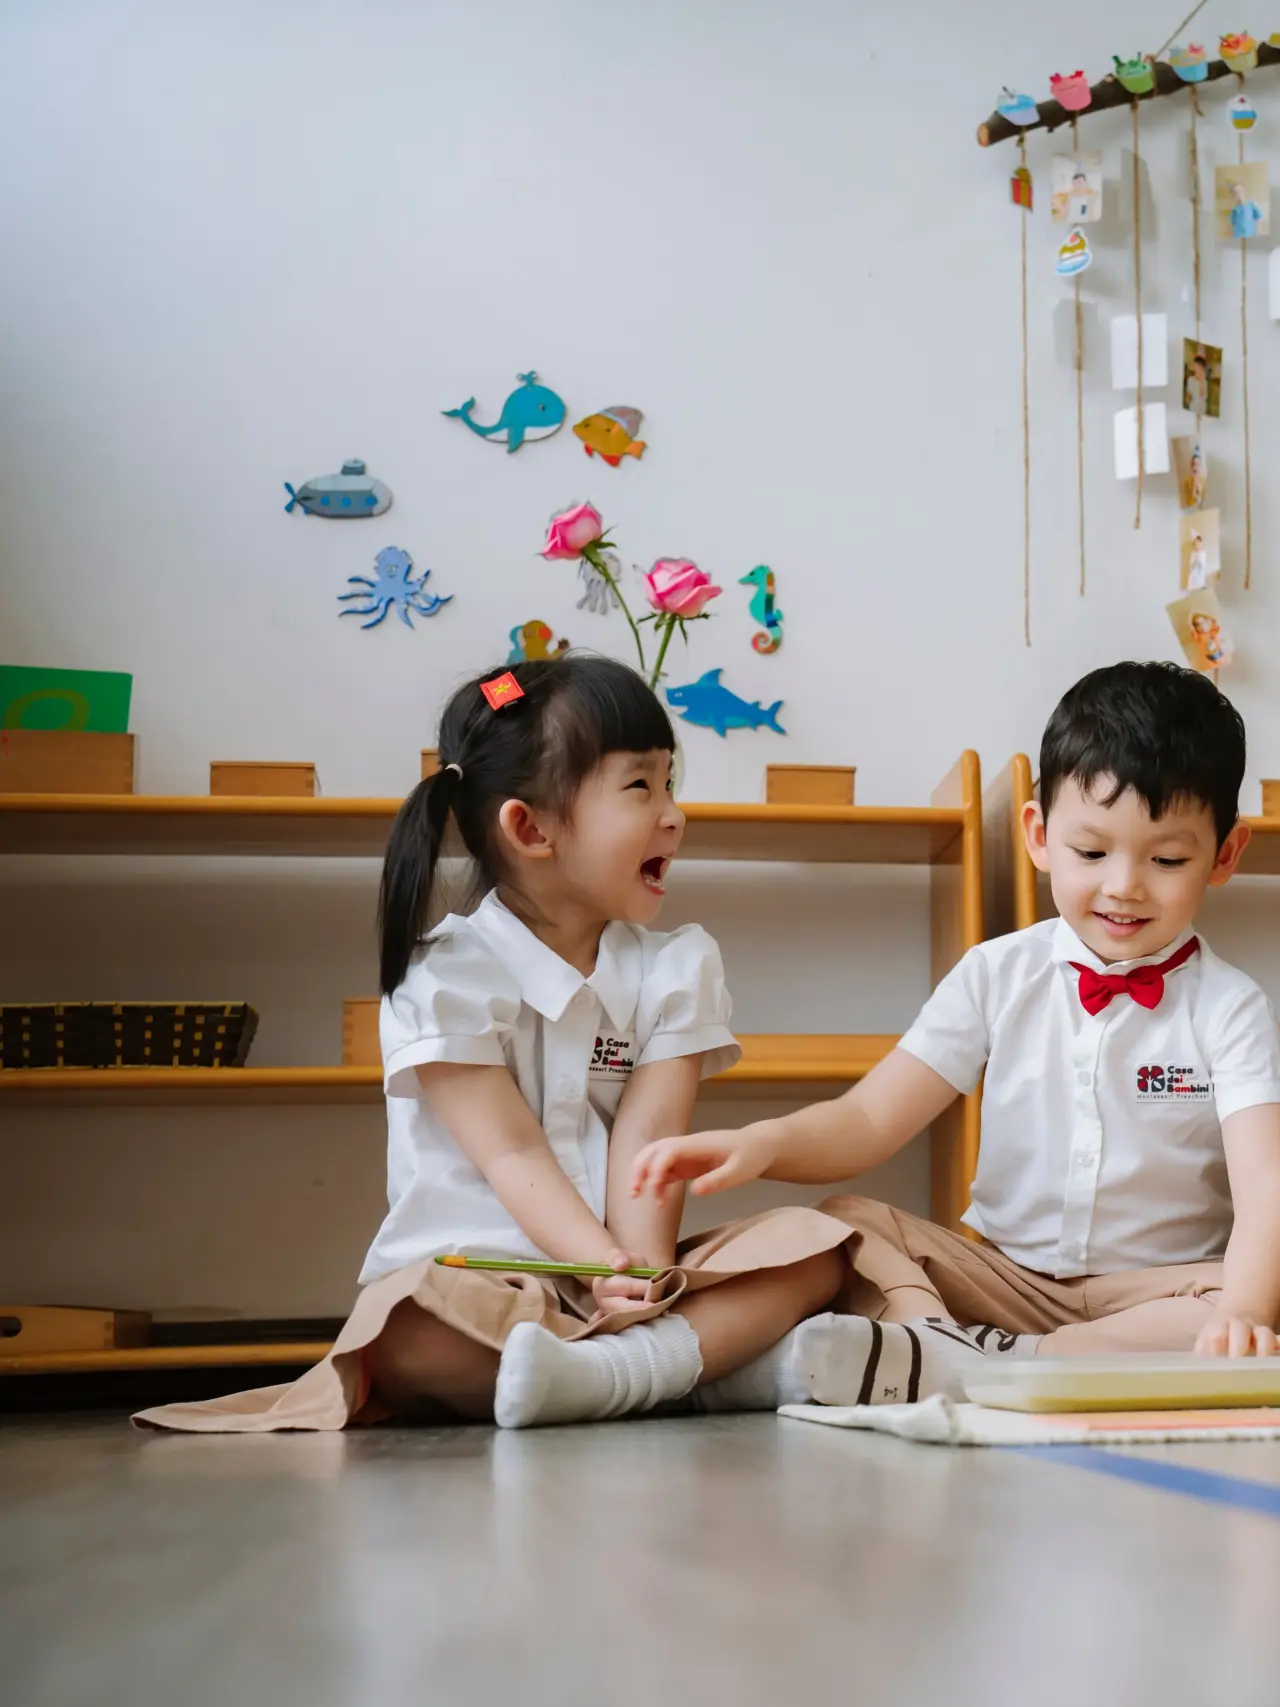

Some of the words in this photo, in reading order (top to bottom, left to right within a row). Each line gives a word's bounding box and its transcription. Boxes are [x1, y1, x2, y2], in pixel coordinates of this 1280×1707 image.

[606, 1038, 630, 1048] Casa
[604, 1047, 619, 1056] dei
[1167, 1065, 1194, 1074] Casa
[1167, 1074, 1183, 1084] dei
[1167, 1084, 1209, 1093] Bambini
